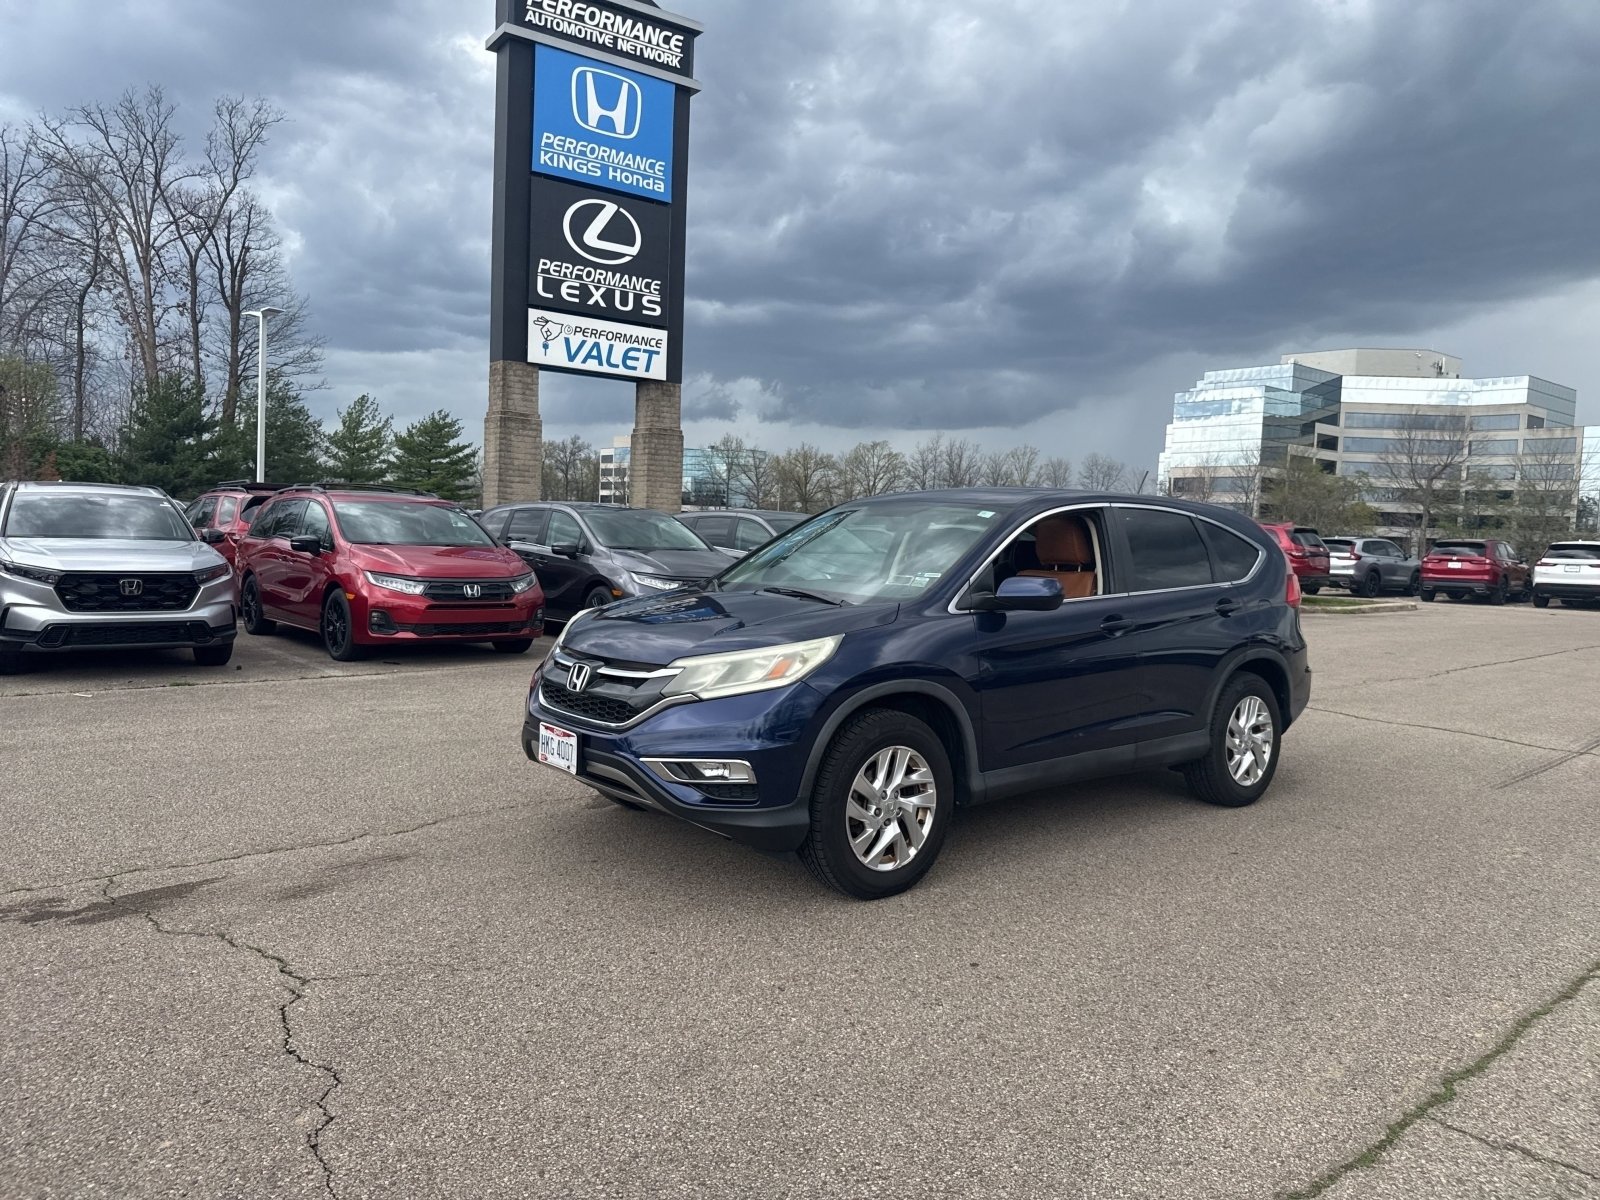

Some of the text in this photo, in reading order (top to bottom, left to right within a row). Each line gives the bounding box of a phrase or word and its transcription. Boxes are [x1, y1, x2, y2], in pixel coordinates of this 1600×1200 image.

[524, 10, 681, 69] AUTOMOTIVE NETWORK
[540, 152, 665, 193] KINGS Honda
[541, 132, 666, 176] PERFORMANCE
[537, 258, 662, 295] PERFORMANCE
[536, 276, 662, 317] LEXUS
[563, 336, 661, 373] VALET
[573, 325, 663, 349] PERFORMANCE
[541, 733, 574, 763] HKG 4007
